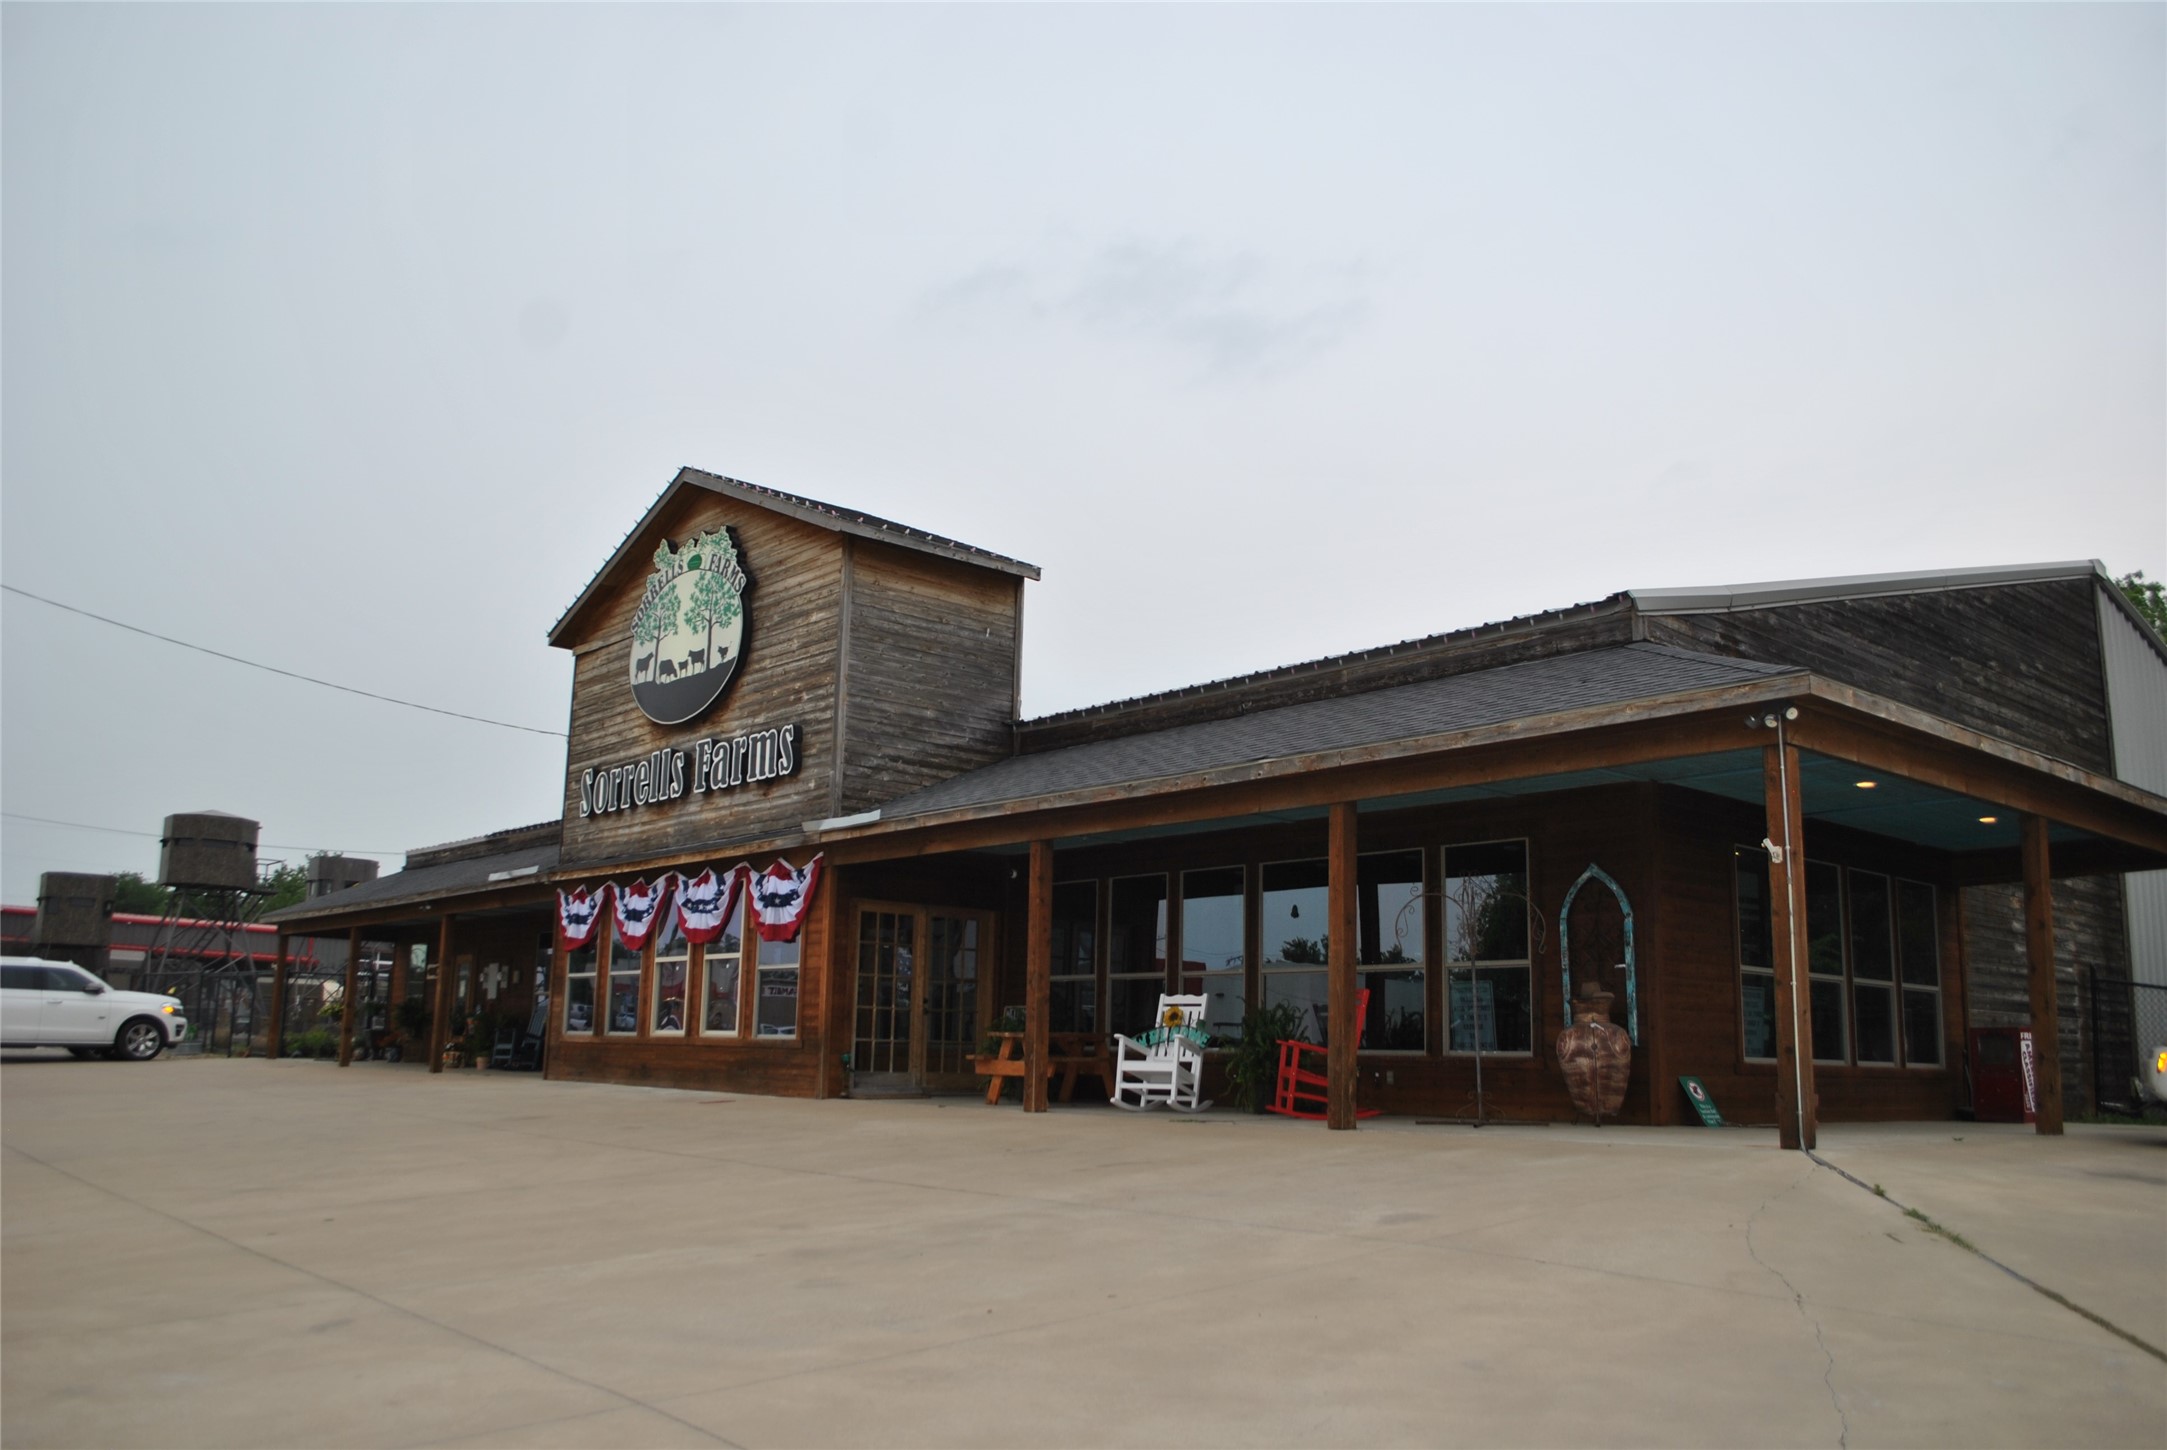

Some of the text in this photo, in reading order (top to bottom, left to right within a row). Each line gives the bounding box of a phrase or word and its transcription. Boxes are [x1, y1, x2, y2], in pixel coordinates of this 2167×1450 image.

[631, 553, 746, 632] SORRELLS FARMS
[579, 723, 794, 818] Sorrells Farms
